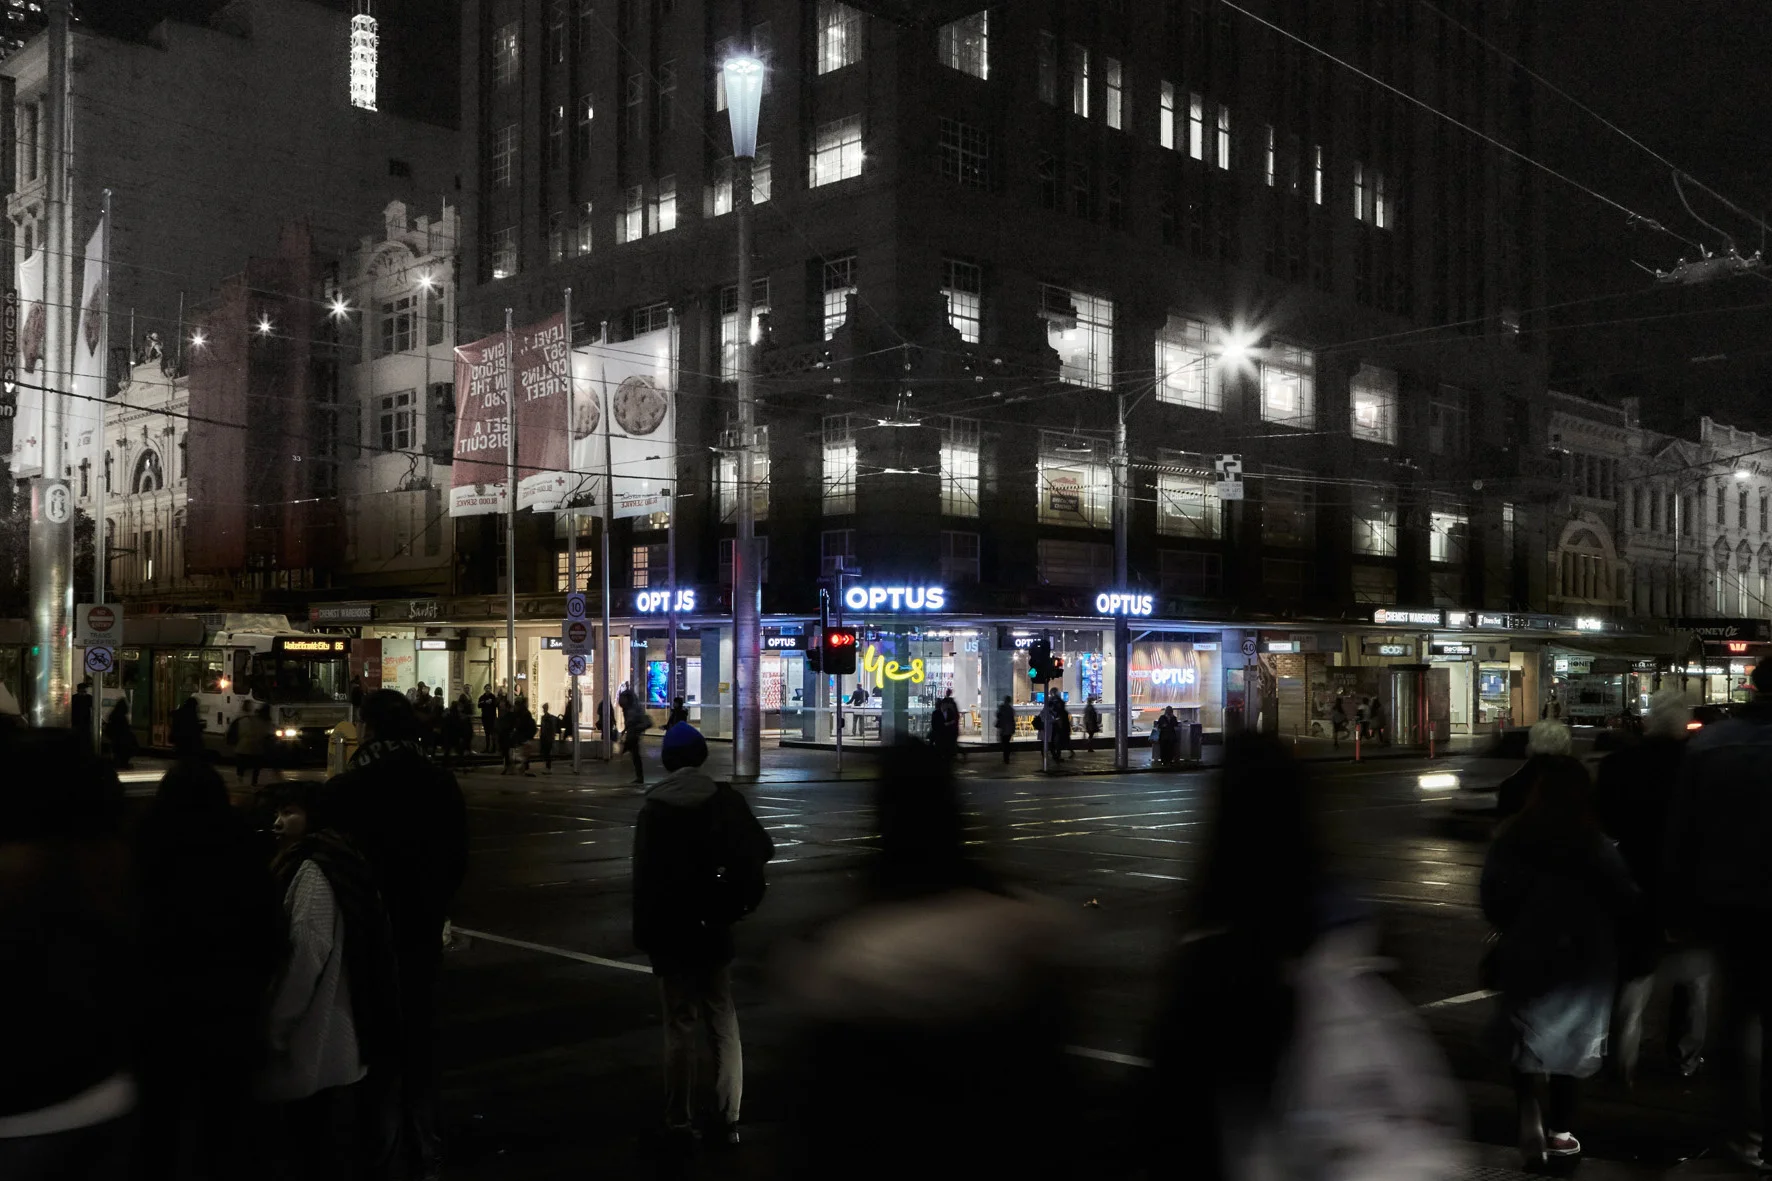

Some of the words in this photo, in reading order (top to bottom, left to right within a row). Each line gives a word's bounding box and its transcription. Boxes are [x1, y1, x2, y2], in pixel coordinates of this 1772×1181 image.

[4, 292, 16, 393] CAUSEWAY
[846, 586, 944, 610] OPTUS
[1095, 592, 1153, 616] OPTUS
[341, 608, 372, 618] WAREHOUSE
[572, 602, 582, 612] 10
[1385, 611, 1408, 622] CHEMIST
[1408, 612, 1440, 624] WAREHOUSE
[767, 637, 796, 647] OPTUS
[1015, 638, 1042, 648] OPT
[1242, 641, 1255, 652] 40
[1151, 668, 1195, 685] OPTUS
